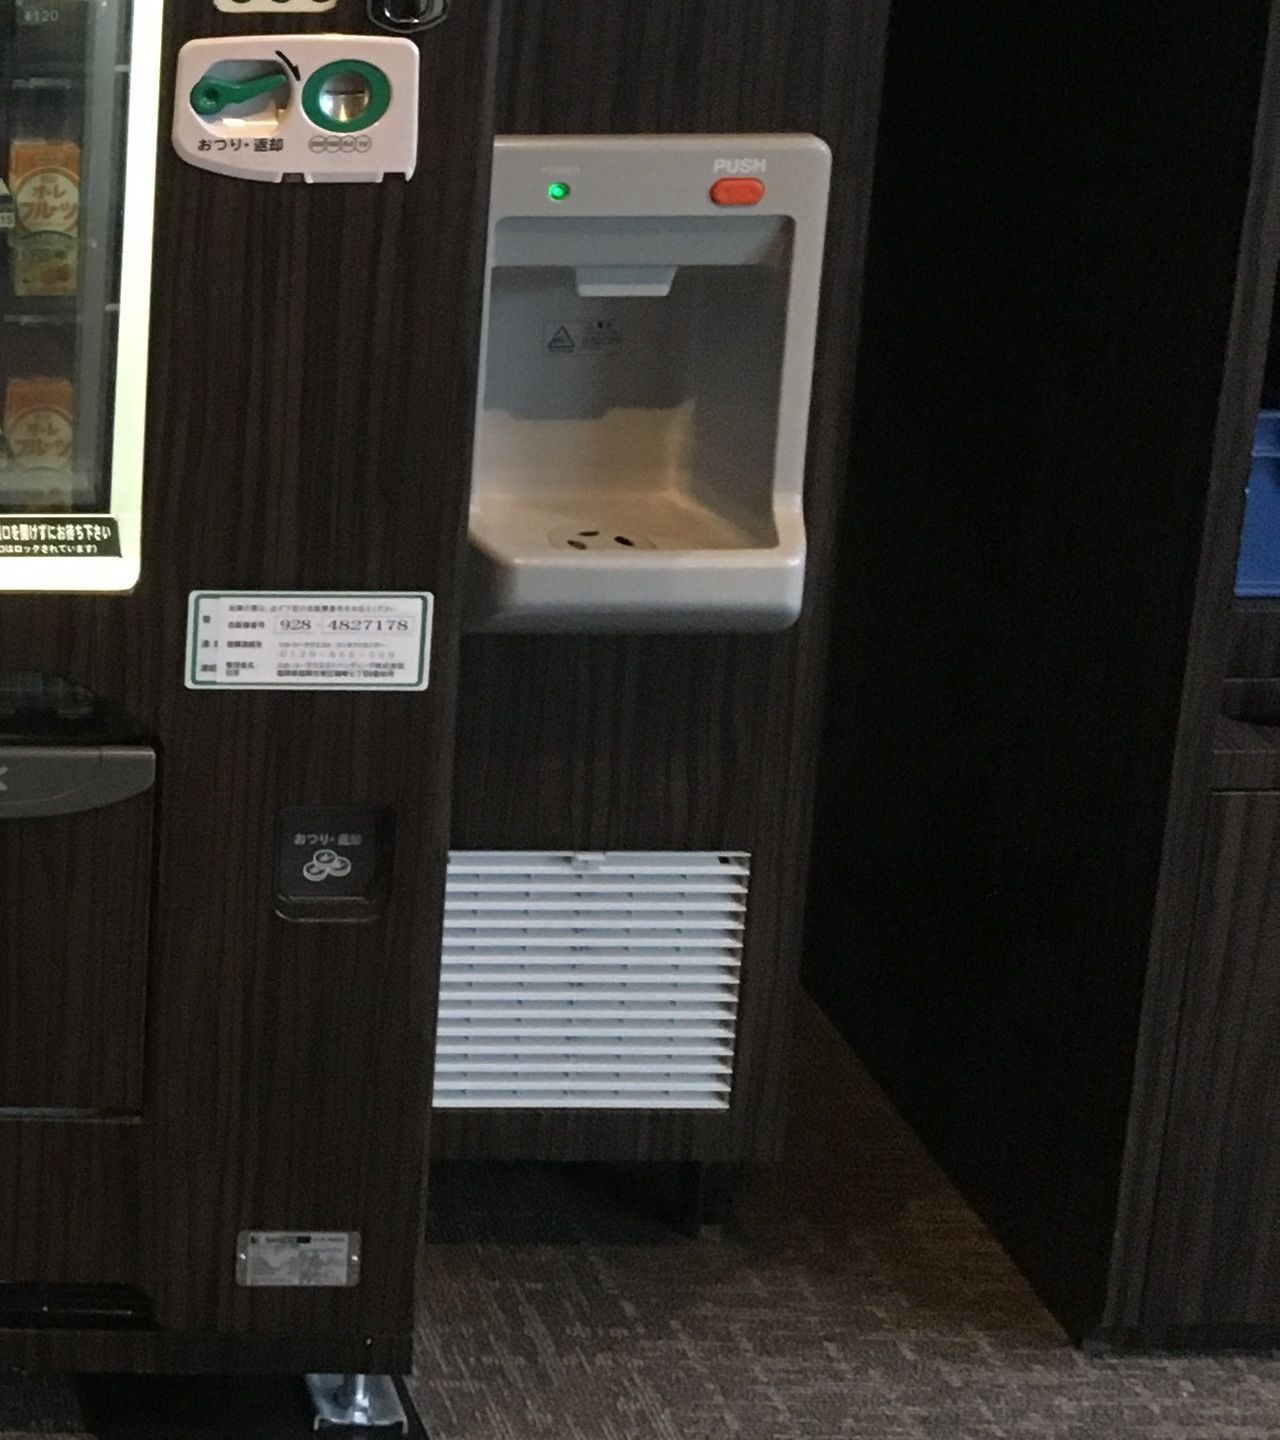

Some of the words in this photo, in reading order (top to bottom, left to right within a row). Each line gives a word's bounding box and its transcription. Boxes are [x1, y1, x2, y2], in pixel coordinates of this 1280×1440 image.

[198, 137, 284, 153] おつり・返却
[712, 158, 767, 173] PUSH
[280, 618, 312, 631] 928
[326, 618, 409, 632] 4827178
